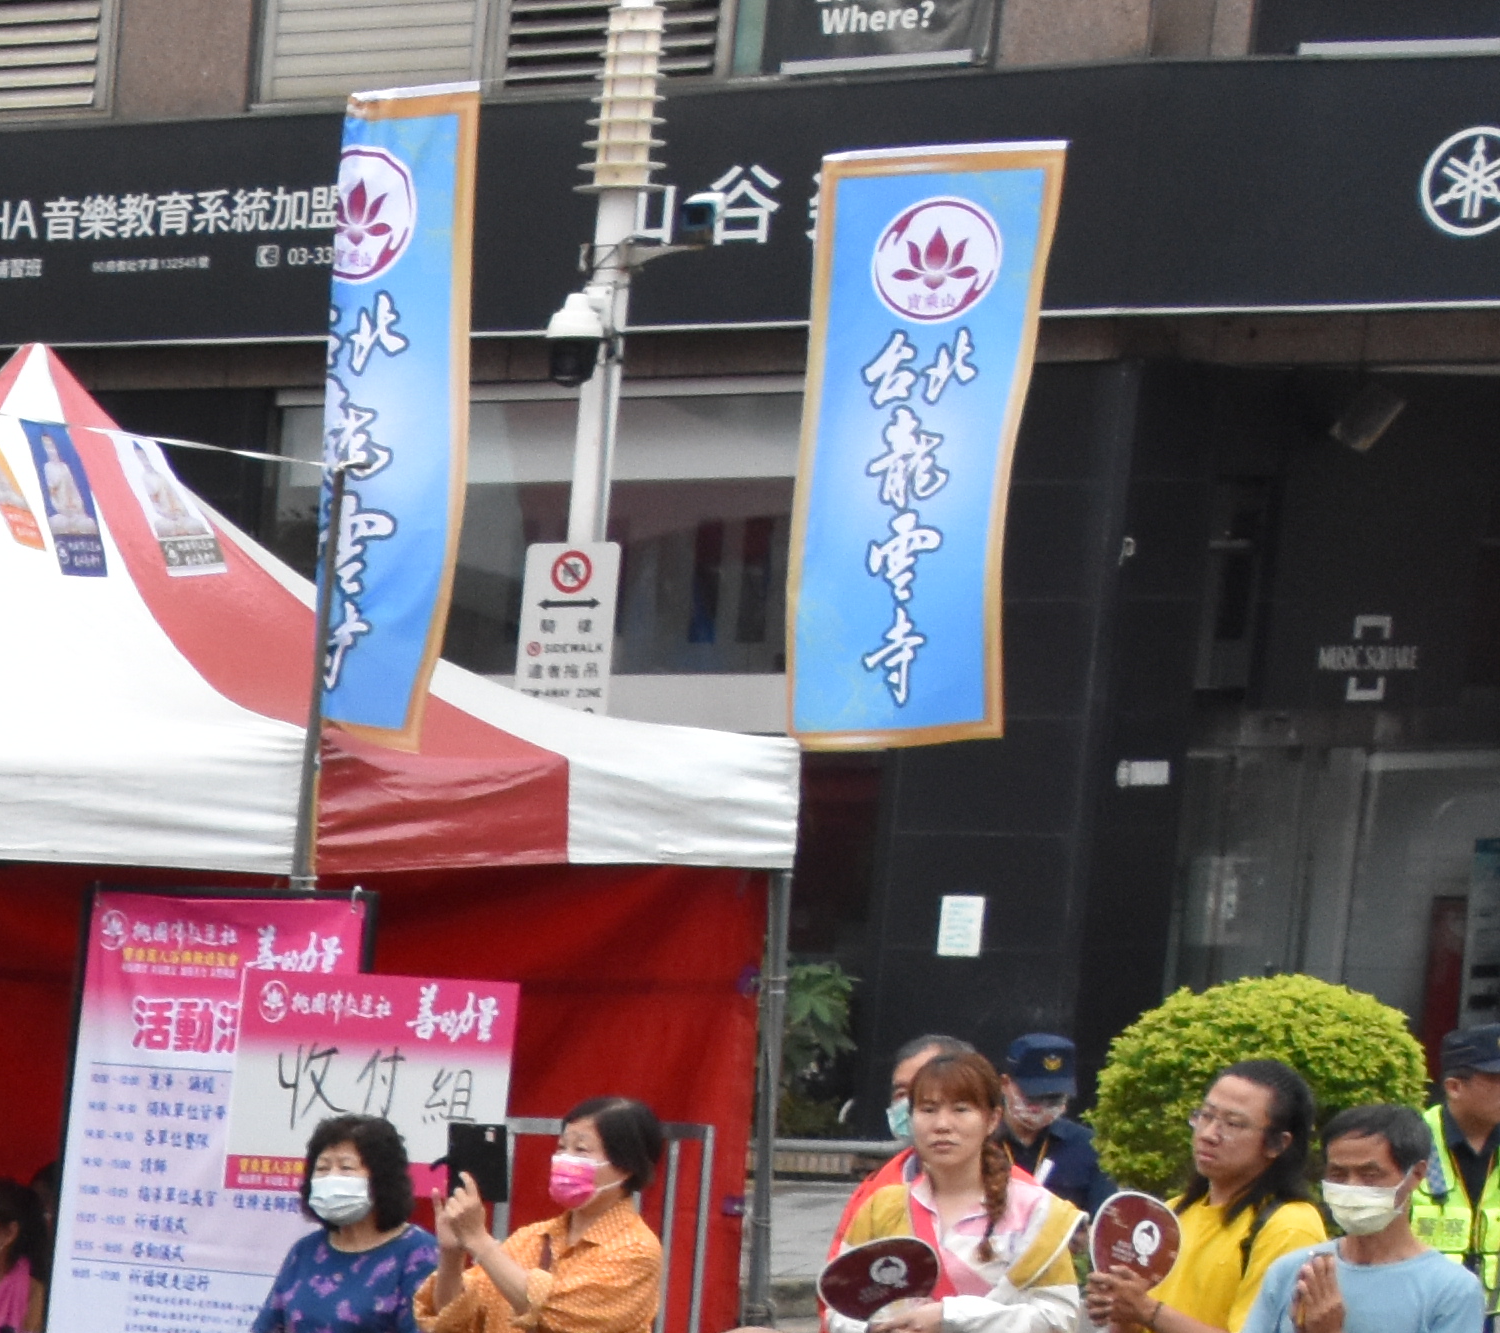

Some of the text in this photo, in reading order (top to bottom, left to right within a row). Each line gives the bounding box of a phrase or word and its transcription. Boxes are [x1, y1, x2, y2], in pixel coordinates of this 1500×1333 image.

[821, 2, 935, 34] Where?
[43, 184, 338, 242] 音樂教育系統加盟
[861, 326, 978, 407] 台北
[862, 408, 951, 707] 龍雲寺
[544, 643, 604, 654] SIDEWALK
[1318, 643, 1419, 672] MUSIC SQUARE
[278, 1043, 478, 1131] 收付組
